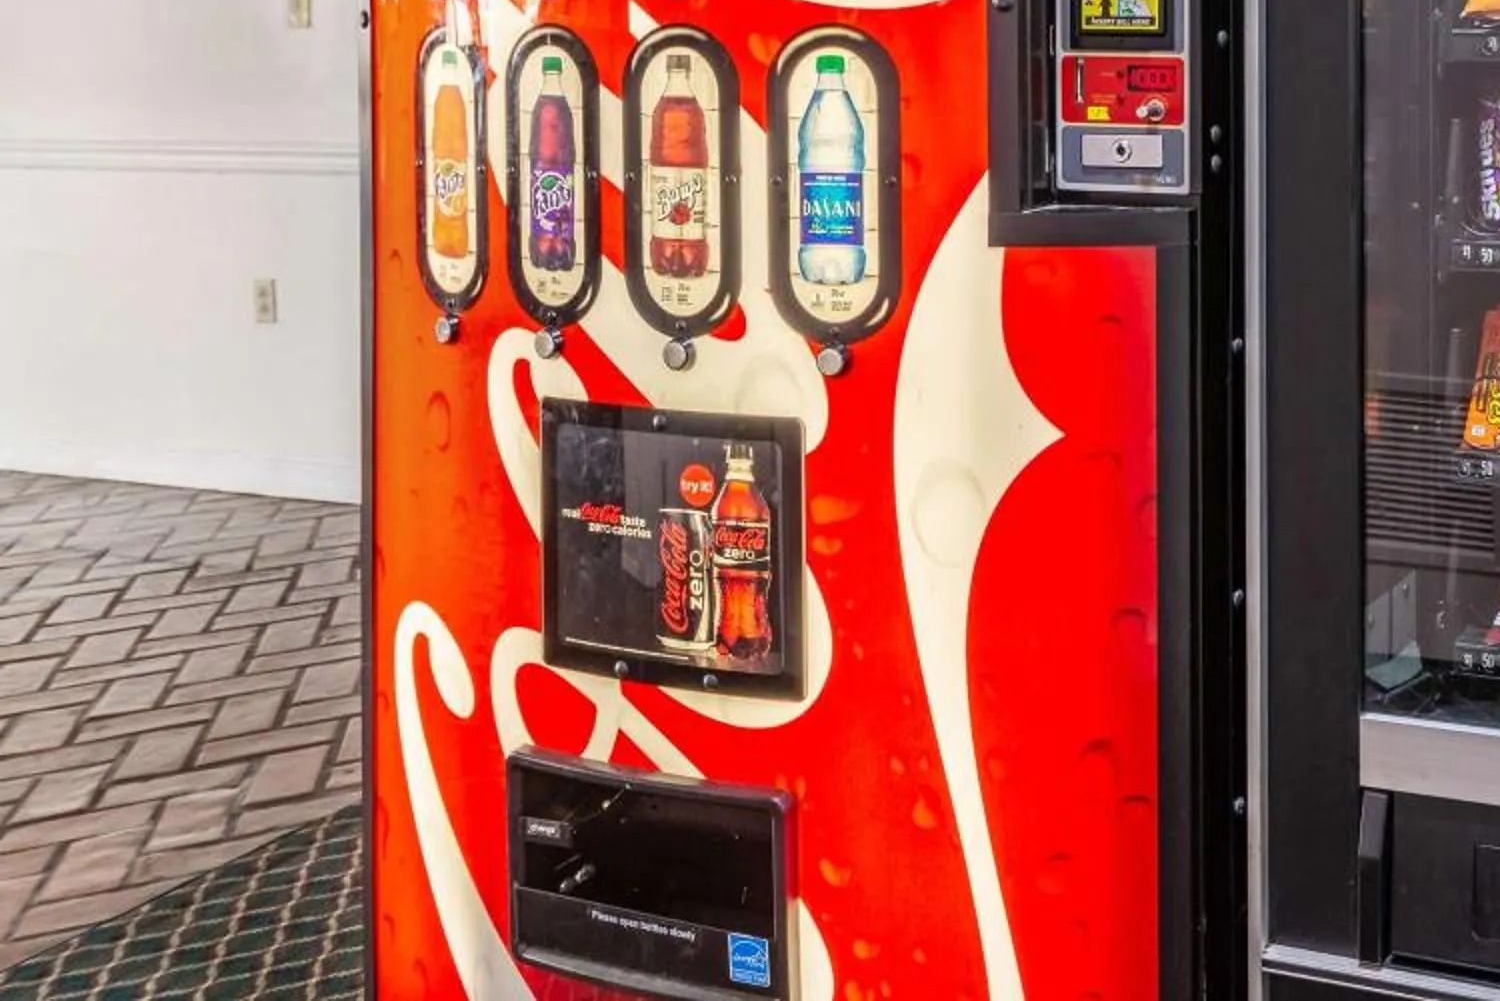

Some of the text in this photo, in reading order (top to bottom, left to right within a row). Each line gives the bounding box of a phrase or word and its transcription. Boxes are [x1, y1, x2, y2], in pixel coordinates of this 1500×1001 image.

[802, 198, 861, 219] DASANI
[680, 477, 698, 493] try
[588, 522, 652, 540] zero calories
[620, 515, 646, 528] taste
[713, 525, 767, 550] Coca-Cola
[723, 546, 756, 561] zero
[659, 519, 690, 633] Coca-Cola
[689, 550, 705, 610] zero
[591, 909, 618, 924] Please
[619, 917, 639, 931] open
[669, 926, 697, 942] slowly
